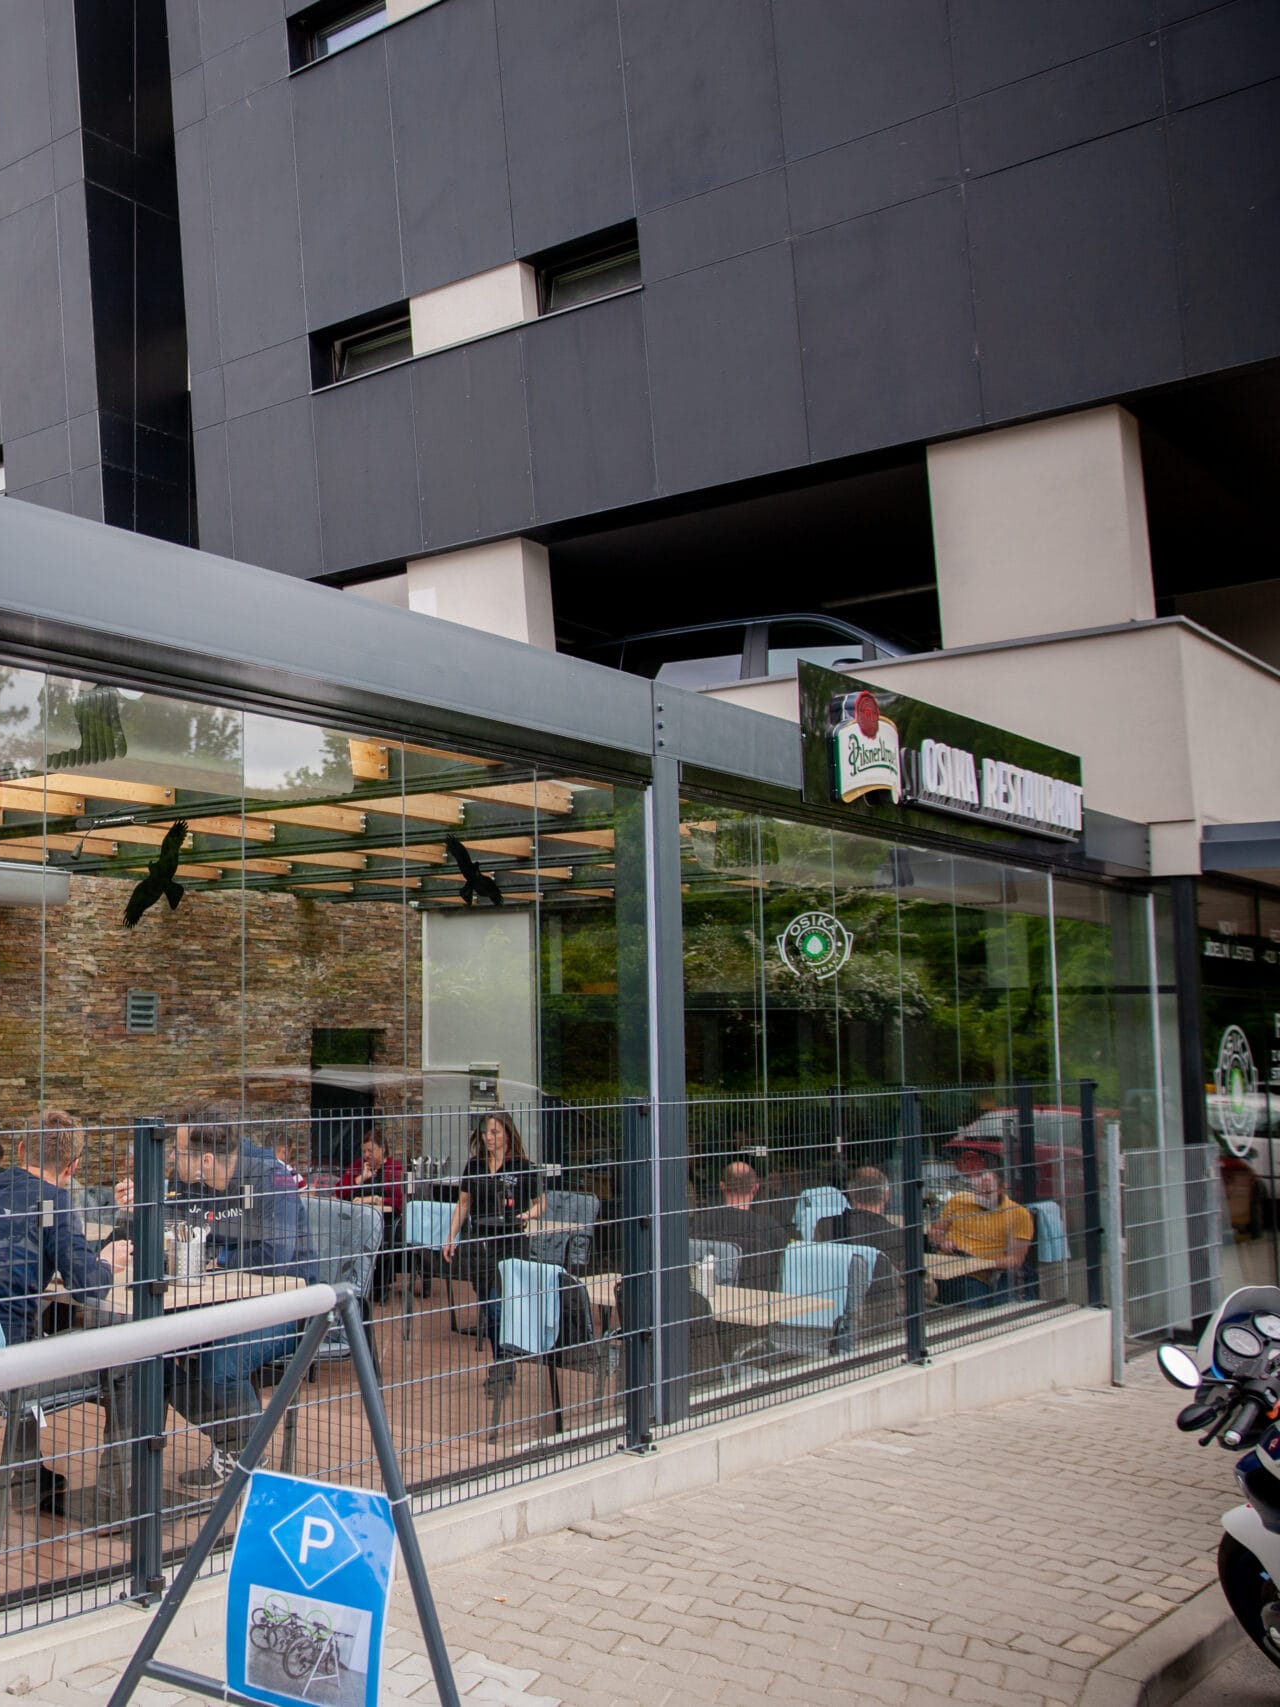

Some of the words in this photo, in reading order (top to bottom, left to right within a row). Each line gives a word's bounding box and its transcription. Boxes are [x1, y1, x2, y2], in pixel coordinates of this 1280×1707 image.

[848, 733, 880, 776] Pilsner
[920, 738, 980, 804] OSIKA
[982, 757, 1084, 832] RESTAURANT
[790, 915, 838, 936] OSIKA
[298, 1515, 335, 1565] P
